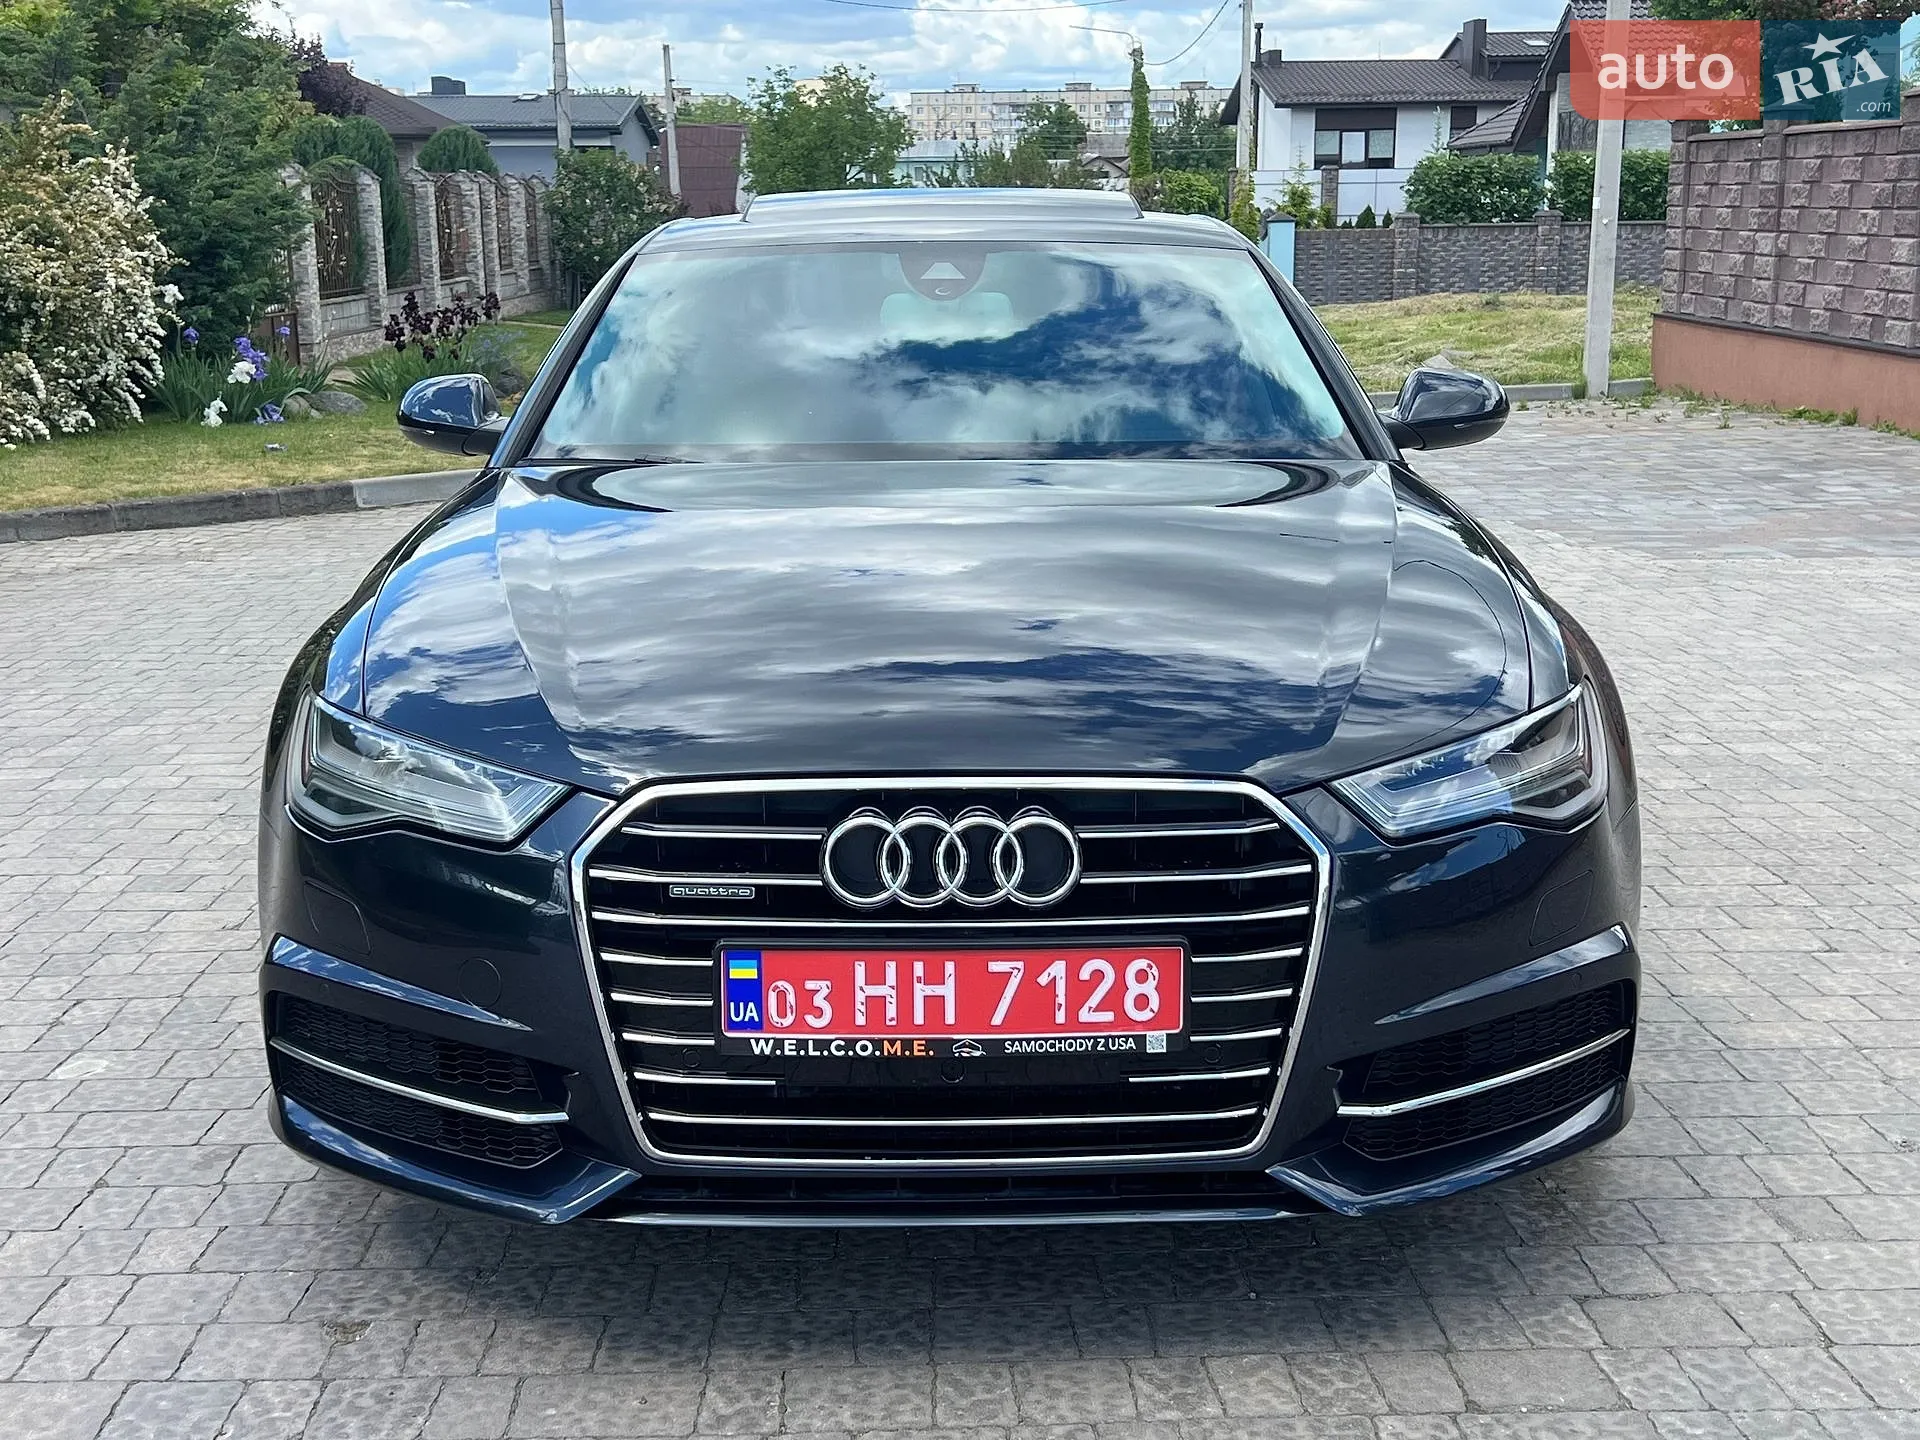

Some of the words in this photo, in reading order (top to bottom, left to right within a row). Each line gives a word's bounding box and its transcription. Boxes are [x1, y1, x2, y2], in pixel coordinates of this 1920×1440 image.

[673, 887, 751, 896] quattro
[767, 979, 833, 1028] 03
[854, 960, 957, 1026] HH
[987, 958, 1160, 1026] 7128
[729, 1003, 759, 1022] UA
[750, 1038, 934, 1056] W.E.L.C.O.M.E.
[1004, 1038, 1095, 1054] SAMOCHODY
[1097, 1038, 1106, 1051] Z
[1108, 1038, 1136, 1051] USA
